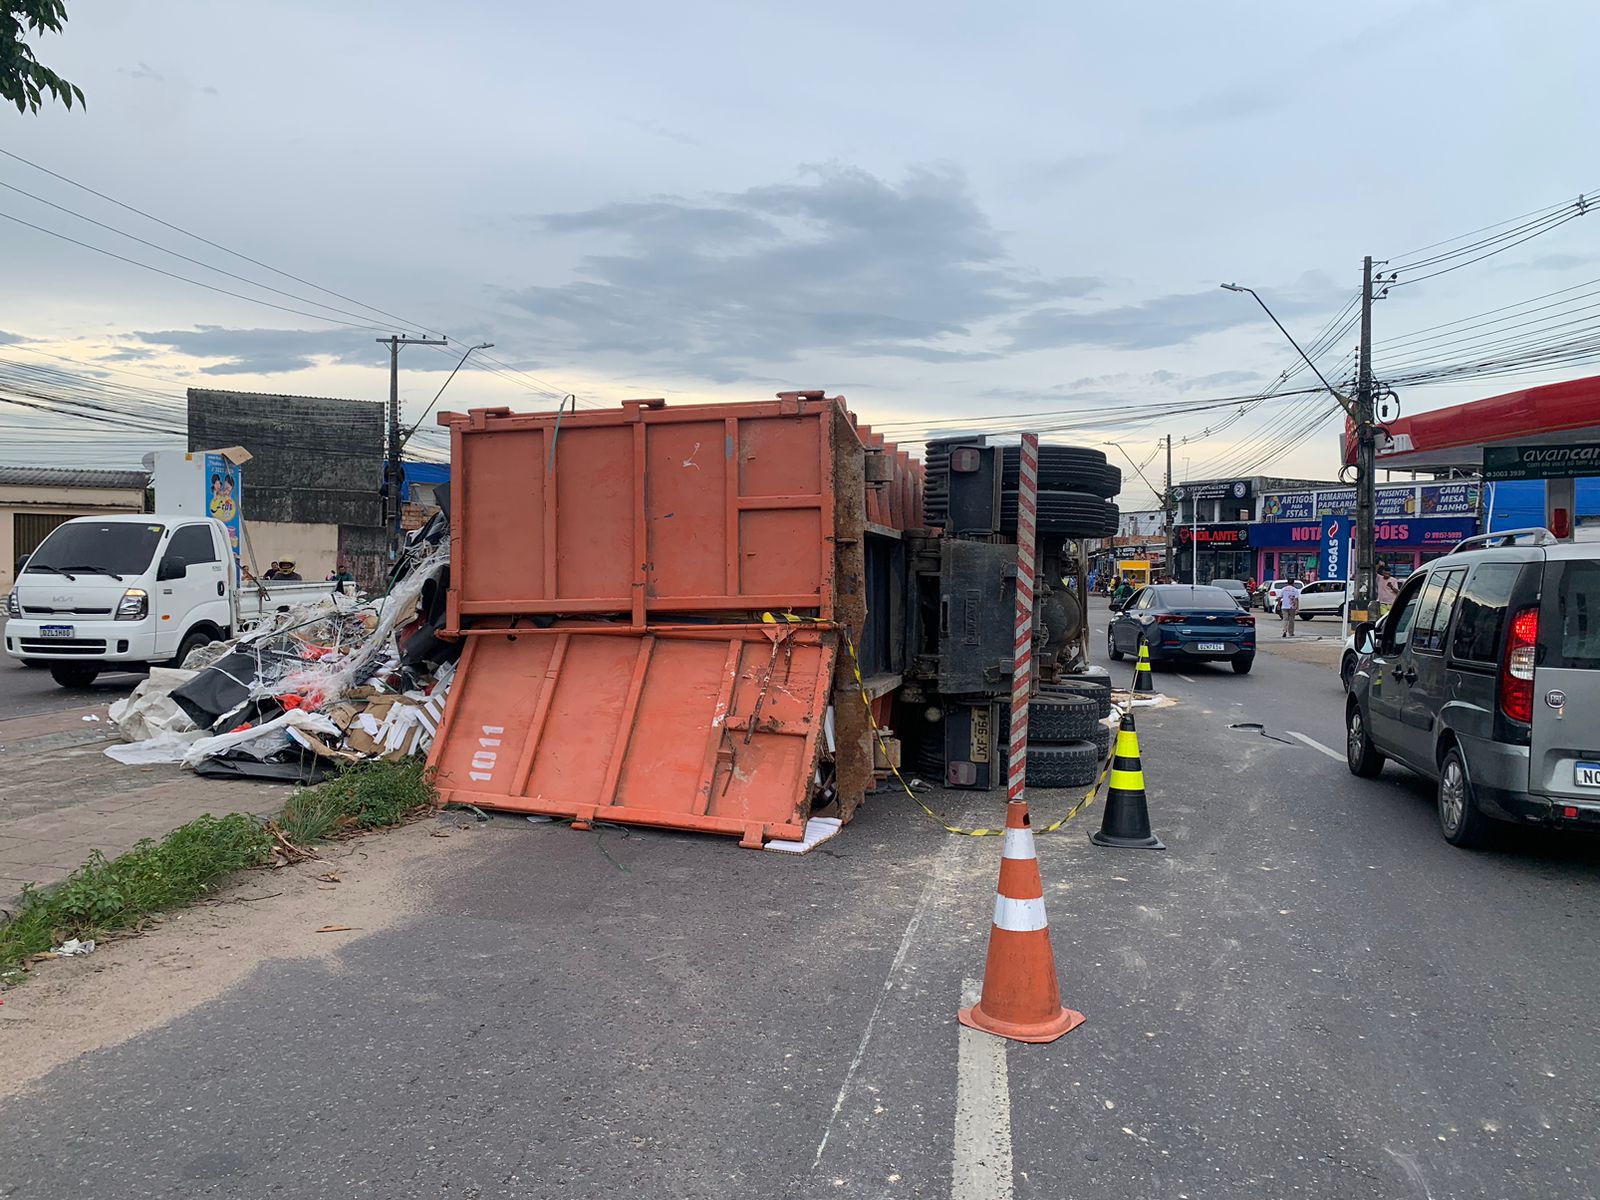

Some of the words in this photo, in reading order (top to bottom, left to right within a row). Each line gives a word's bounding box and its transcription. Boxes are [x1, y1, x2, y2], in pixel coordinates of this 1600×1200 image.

[1377, 489, 1410, 498] PRESENTES
[1439, 486, 1466, 494] CAMA
[1281, 495, 1313, 505] ARTIGOS
[1379, 497, 1406, 505] ARTIGOS
[1440, 495, 1464, 503] MESA
[1317, 500, 1357, 509] PAPELARIA
[1436, 503, 1469, 512] BANHO
[1328, 539, 1339, 578] FOGAS
[468, 725, 504, 782] 1011
